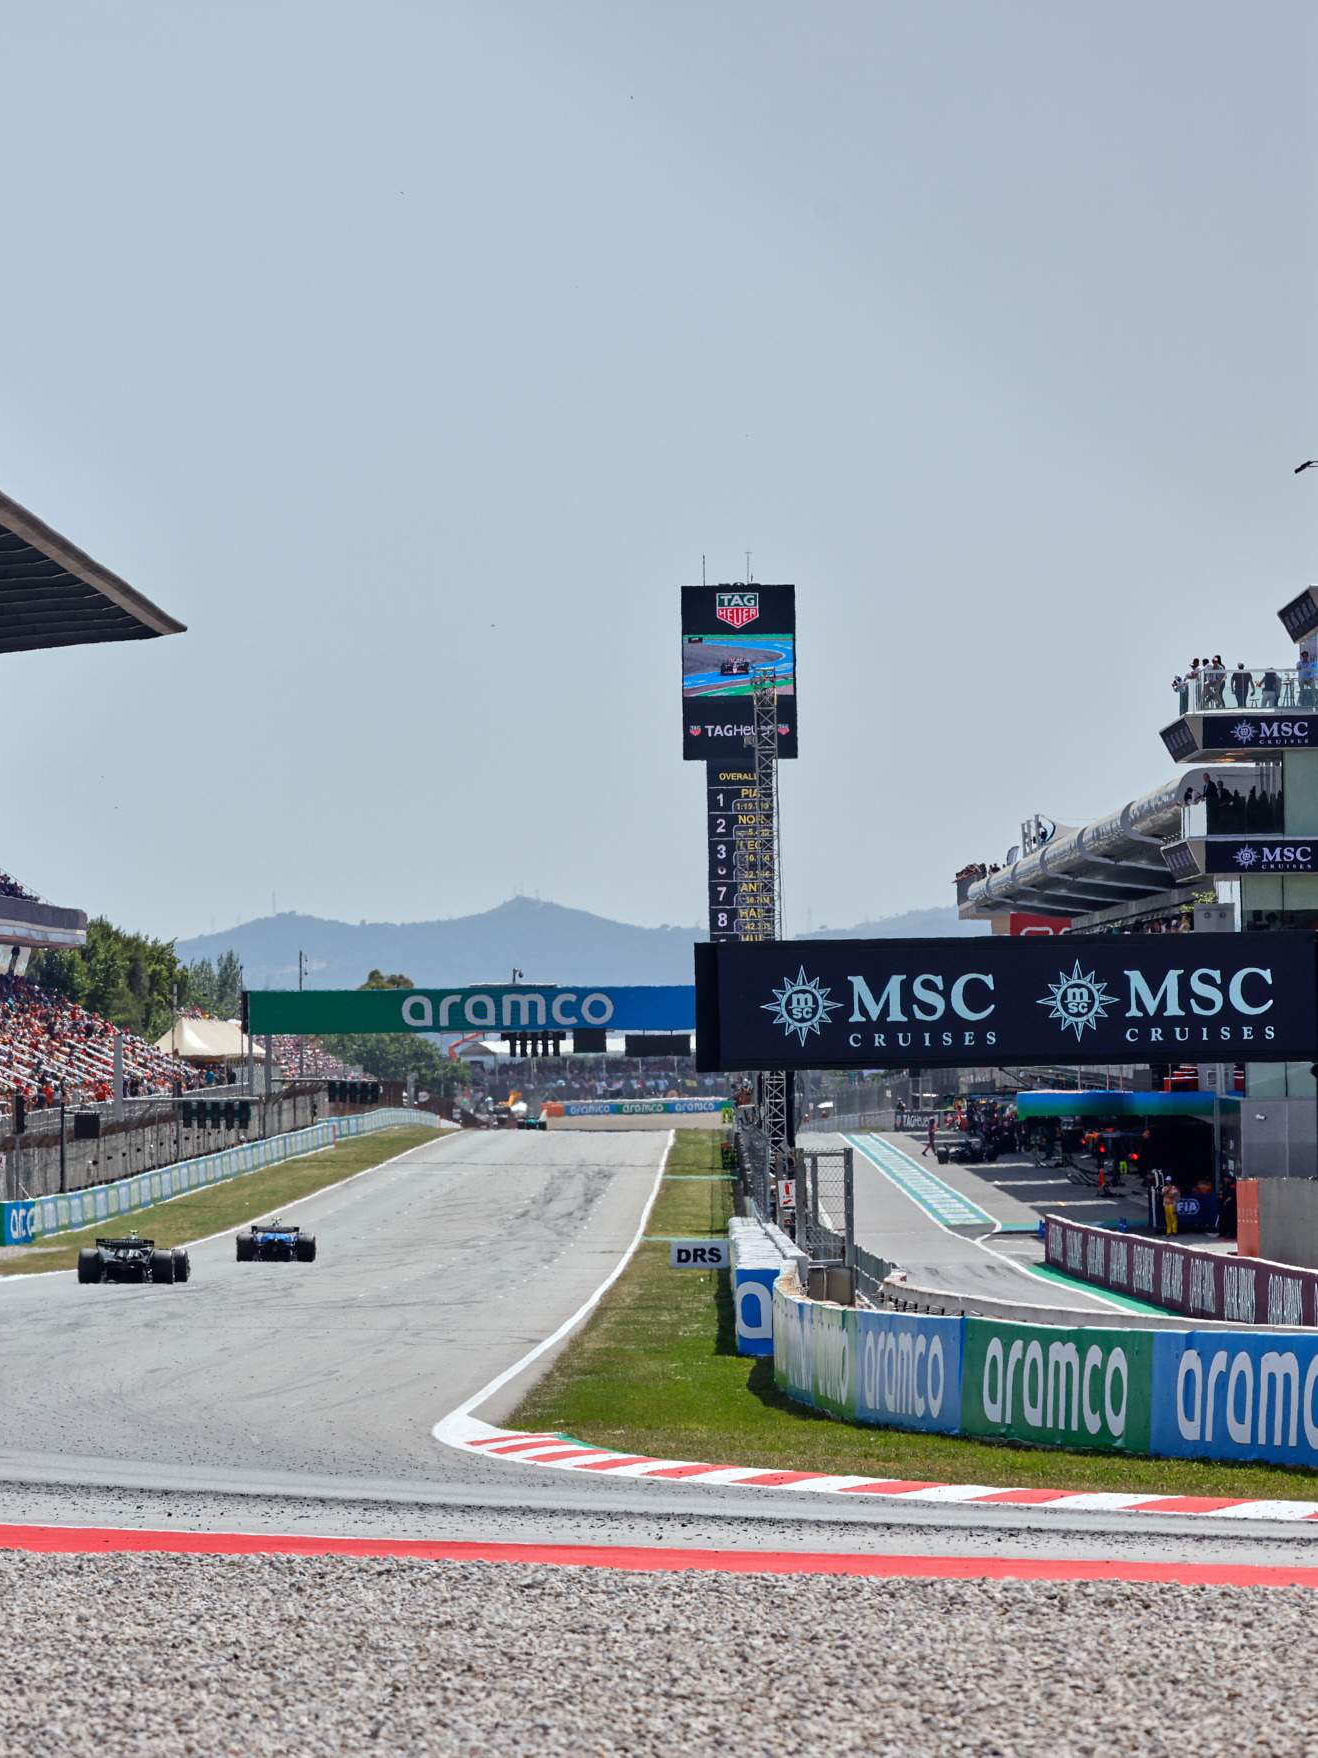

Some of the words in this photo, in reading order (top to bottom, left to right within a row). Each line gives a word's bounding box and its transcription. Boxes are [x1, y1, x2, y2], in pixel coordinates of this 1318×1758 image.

[720, 595, 755, 606] TAG
[718, 608, 756, 625] HEUER
[1259, 722, 1309, 737] MSC
[716, 793, 724, 807] 1
[716, 819, 726, 833] 2
[716, 844, 727, 859] 3
[1262, 847, 1312, 862] MSC
[717, 887, 727, 901] 7
[718, 913, 728, 927] 8
[848, 973, 996, 1022] MSC
[1124, 968, 1274, 1017] MSC
[402, 993, 614, 1027] aramco
[850, 1032, 997, 1047] CRUISES
[1126, 1025, 1275, 1041] CRUISES
[1177, 1202, 1198, 1211] FIA
[677, 1248, 722, 1263] DRS
[865, 1330, 944, 1419] aramco
[983, 1337, 1128, 1437] aramco
